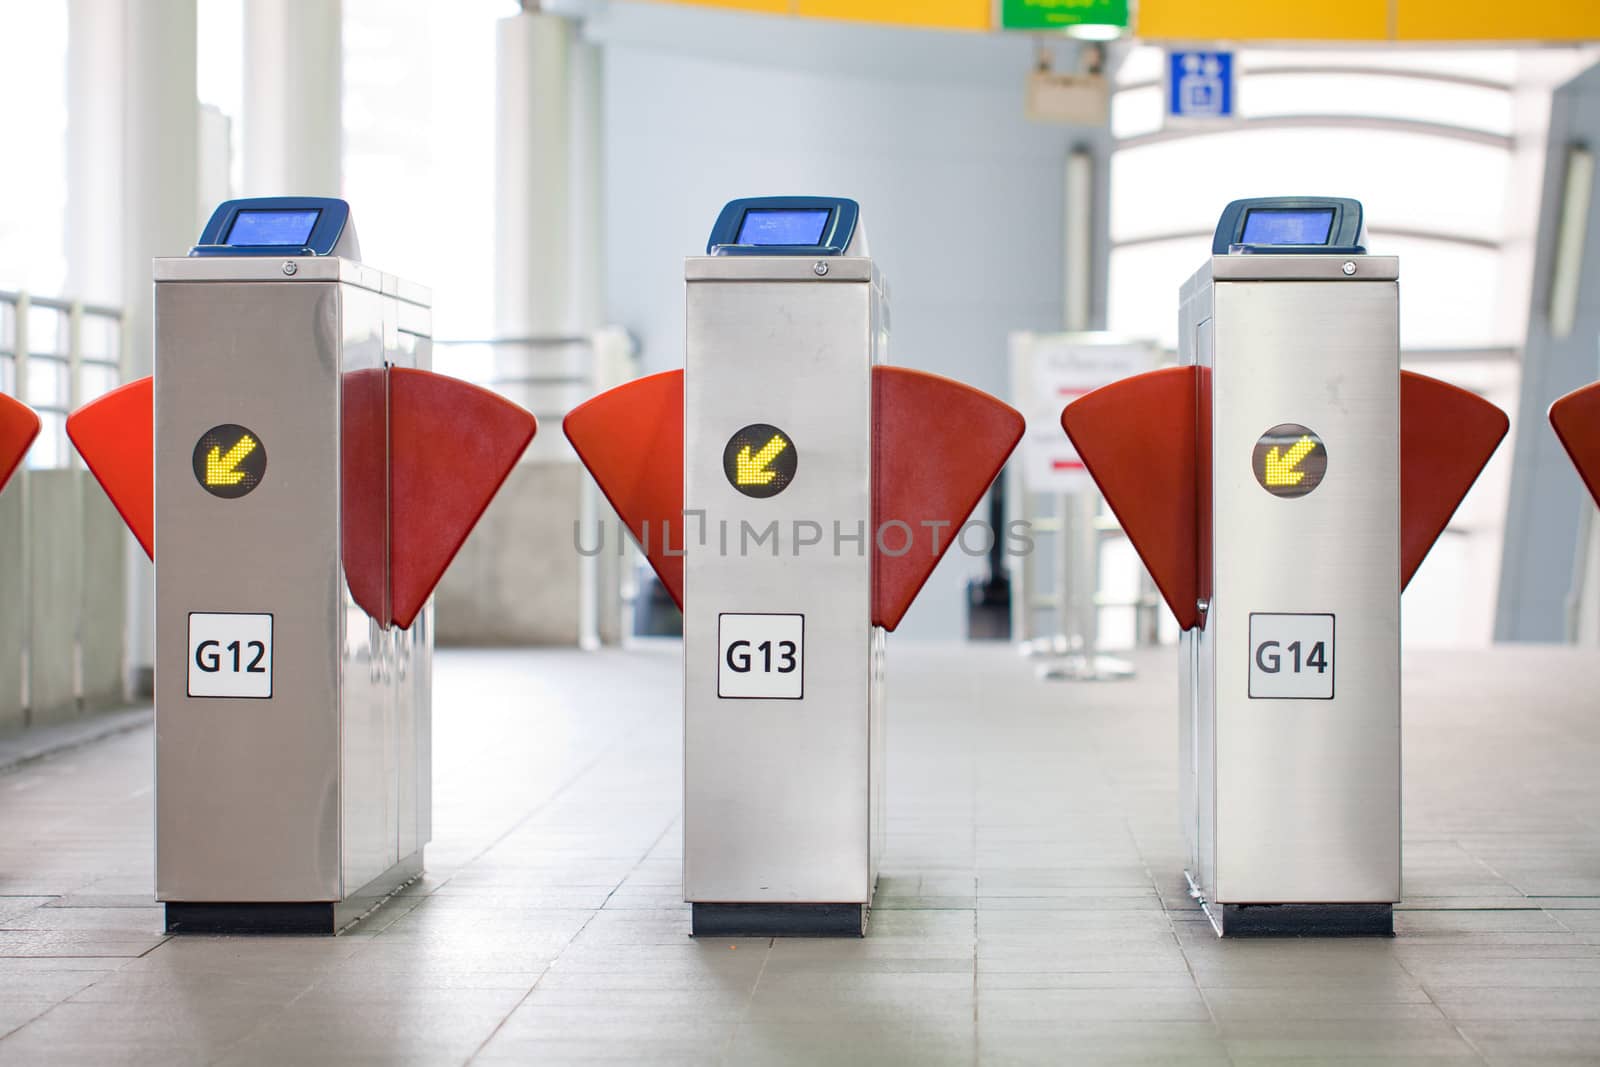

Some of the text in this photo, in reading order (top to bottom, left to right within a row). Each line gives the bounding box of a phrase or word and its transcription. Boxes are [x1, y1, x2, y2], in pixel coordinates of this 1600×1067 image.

[195, 640, 266, 673] G12
[726, 640, 798, 674] G13
[1255, 640, 1328, 674] G14
